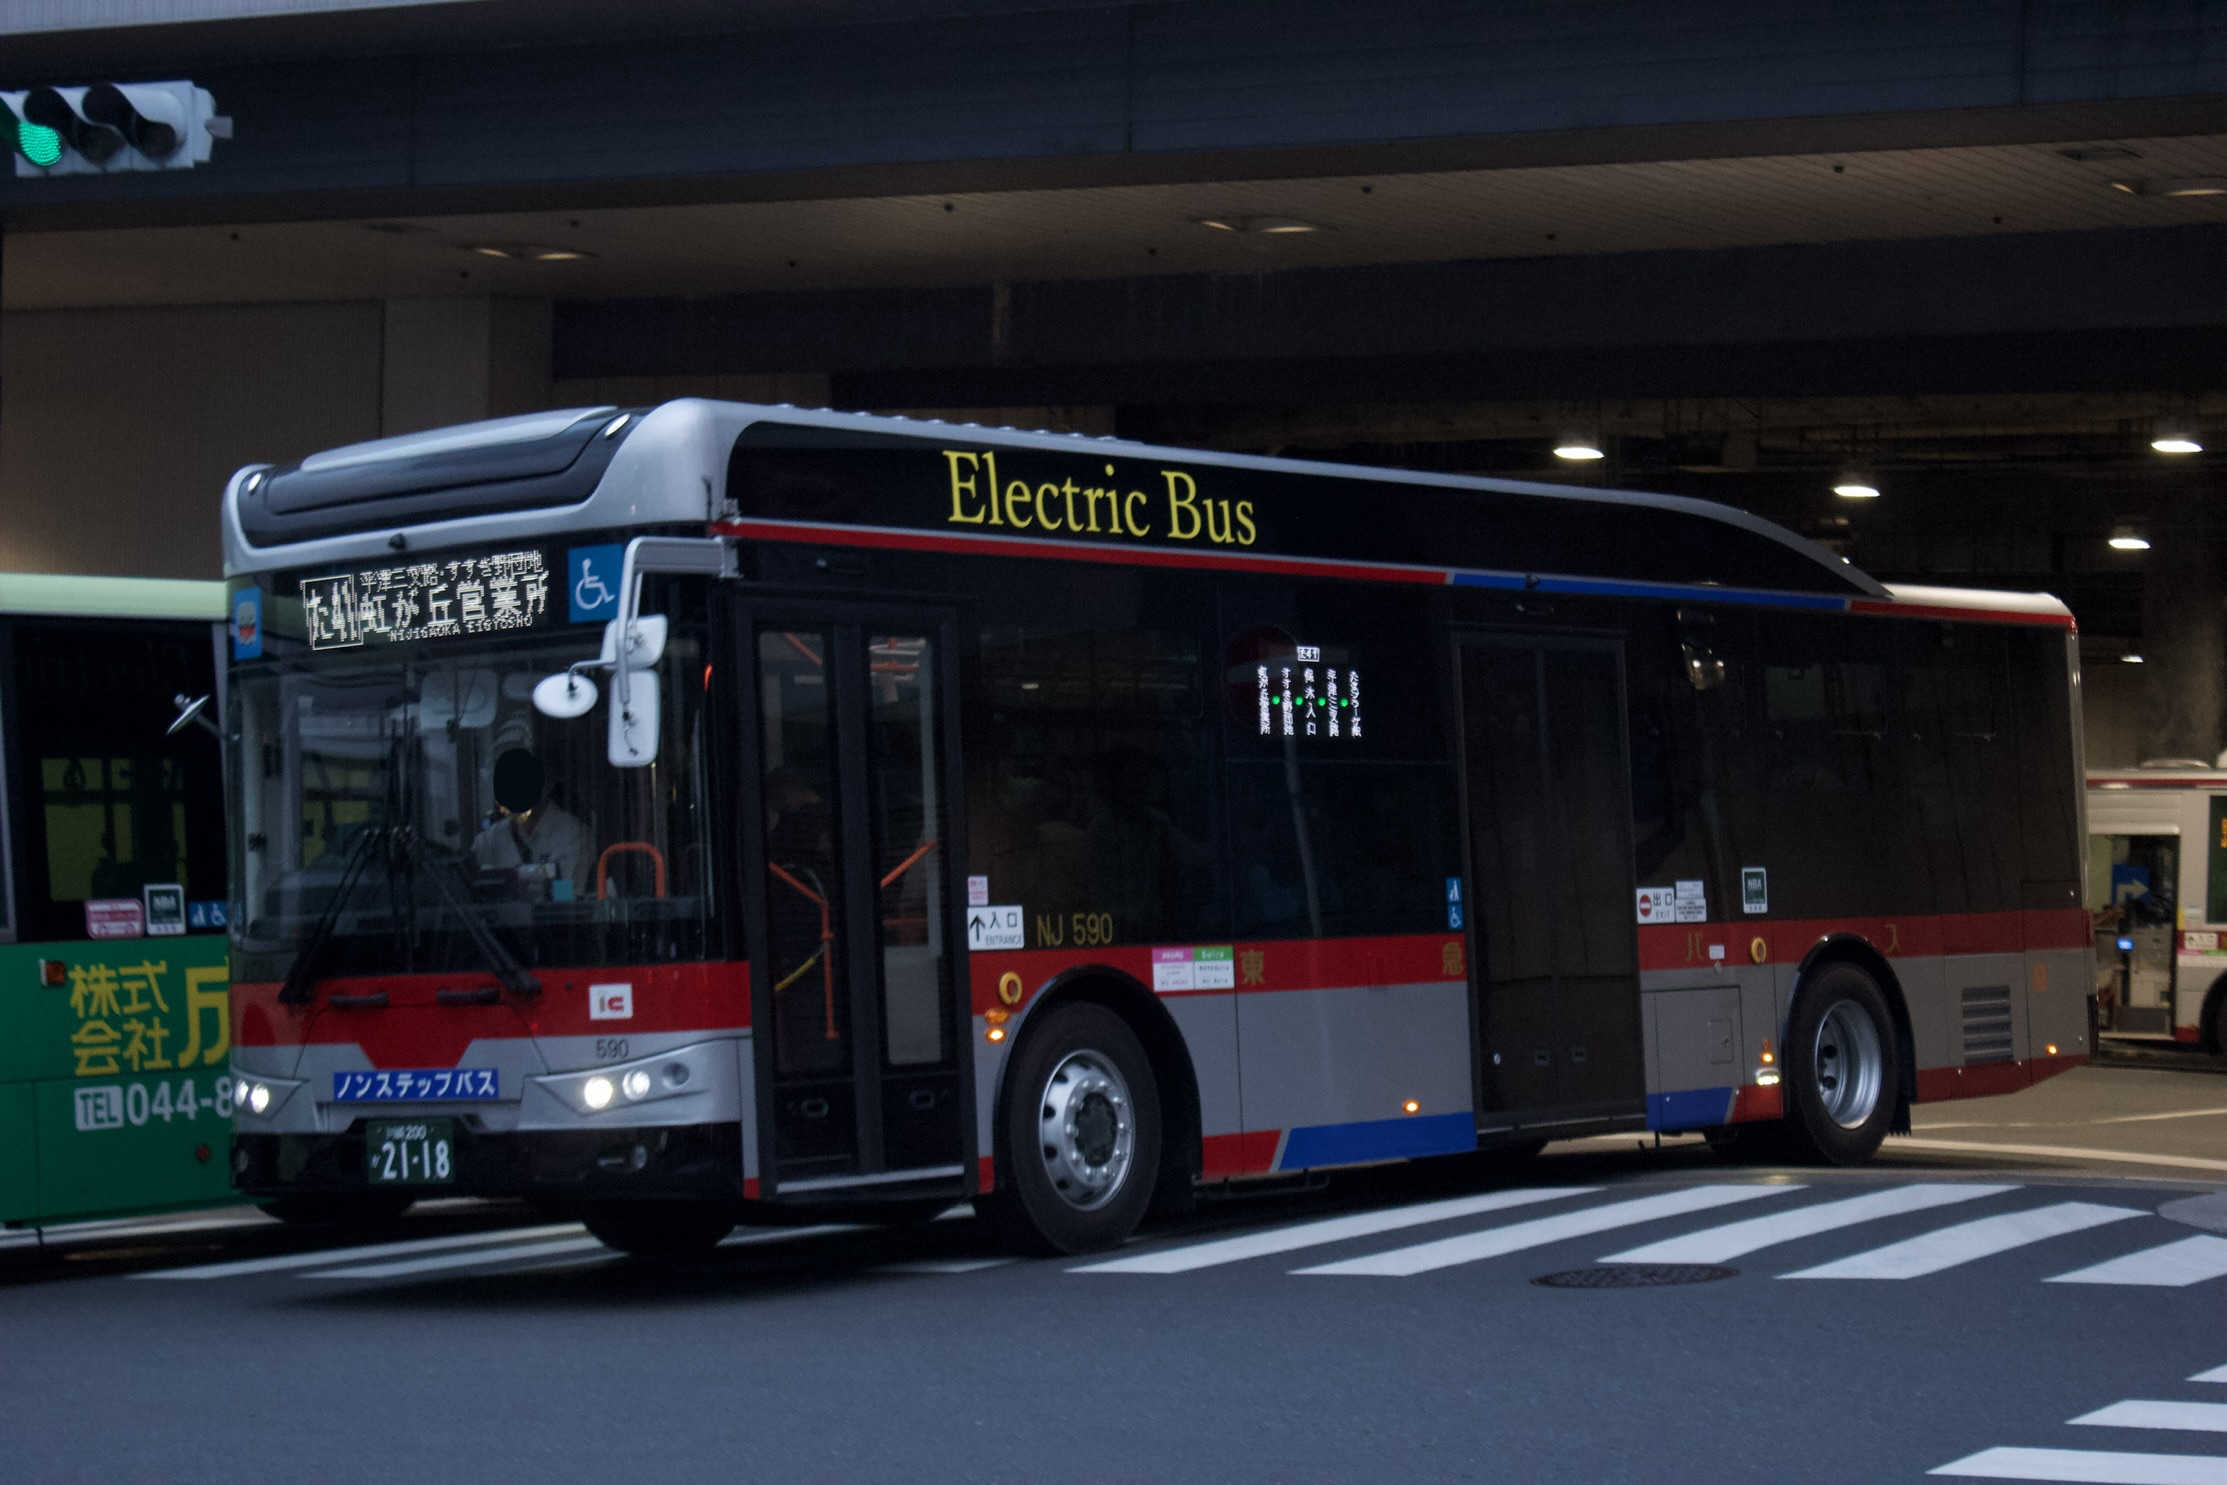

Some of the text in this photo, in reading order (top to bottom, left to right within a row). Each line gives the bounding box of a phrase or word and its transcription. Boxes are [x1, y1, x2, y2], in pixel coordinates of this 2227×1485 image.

[942, 450, 1257, 545] Electric Bus
[360, 571, 549, 633] 虹が丘営業所
[1653, 893, 1673, 907] 出口
[989, 912, 1017, 928] 入口
[1036, 912, 1113, 948] NJ 590
[1241, 949, 1264, 986] 東
[68, 960, 170, 1018] 株式
[71, 1016, 172, 1077] 会社
[596, 1038, 629, 1059] 590
[338, 1071, 497, 1099] ノンステップバス
[80, 1093, 119, 1126] TEL
